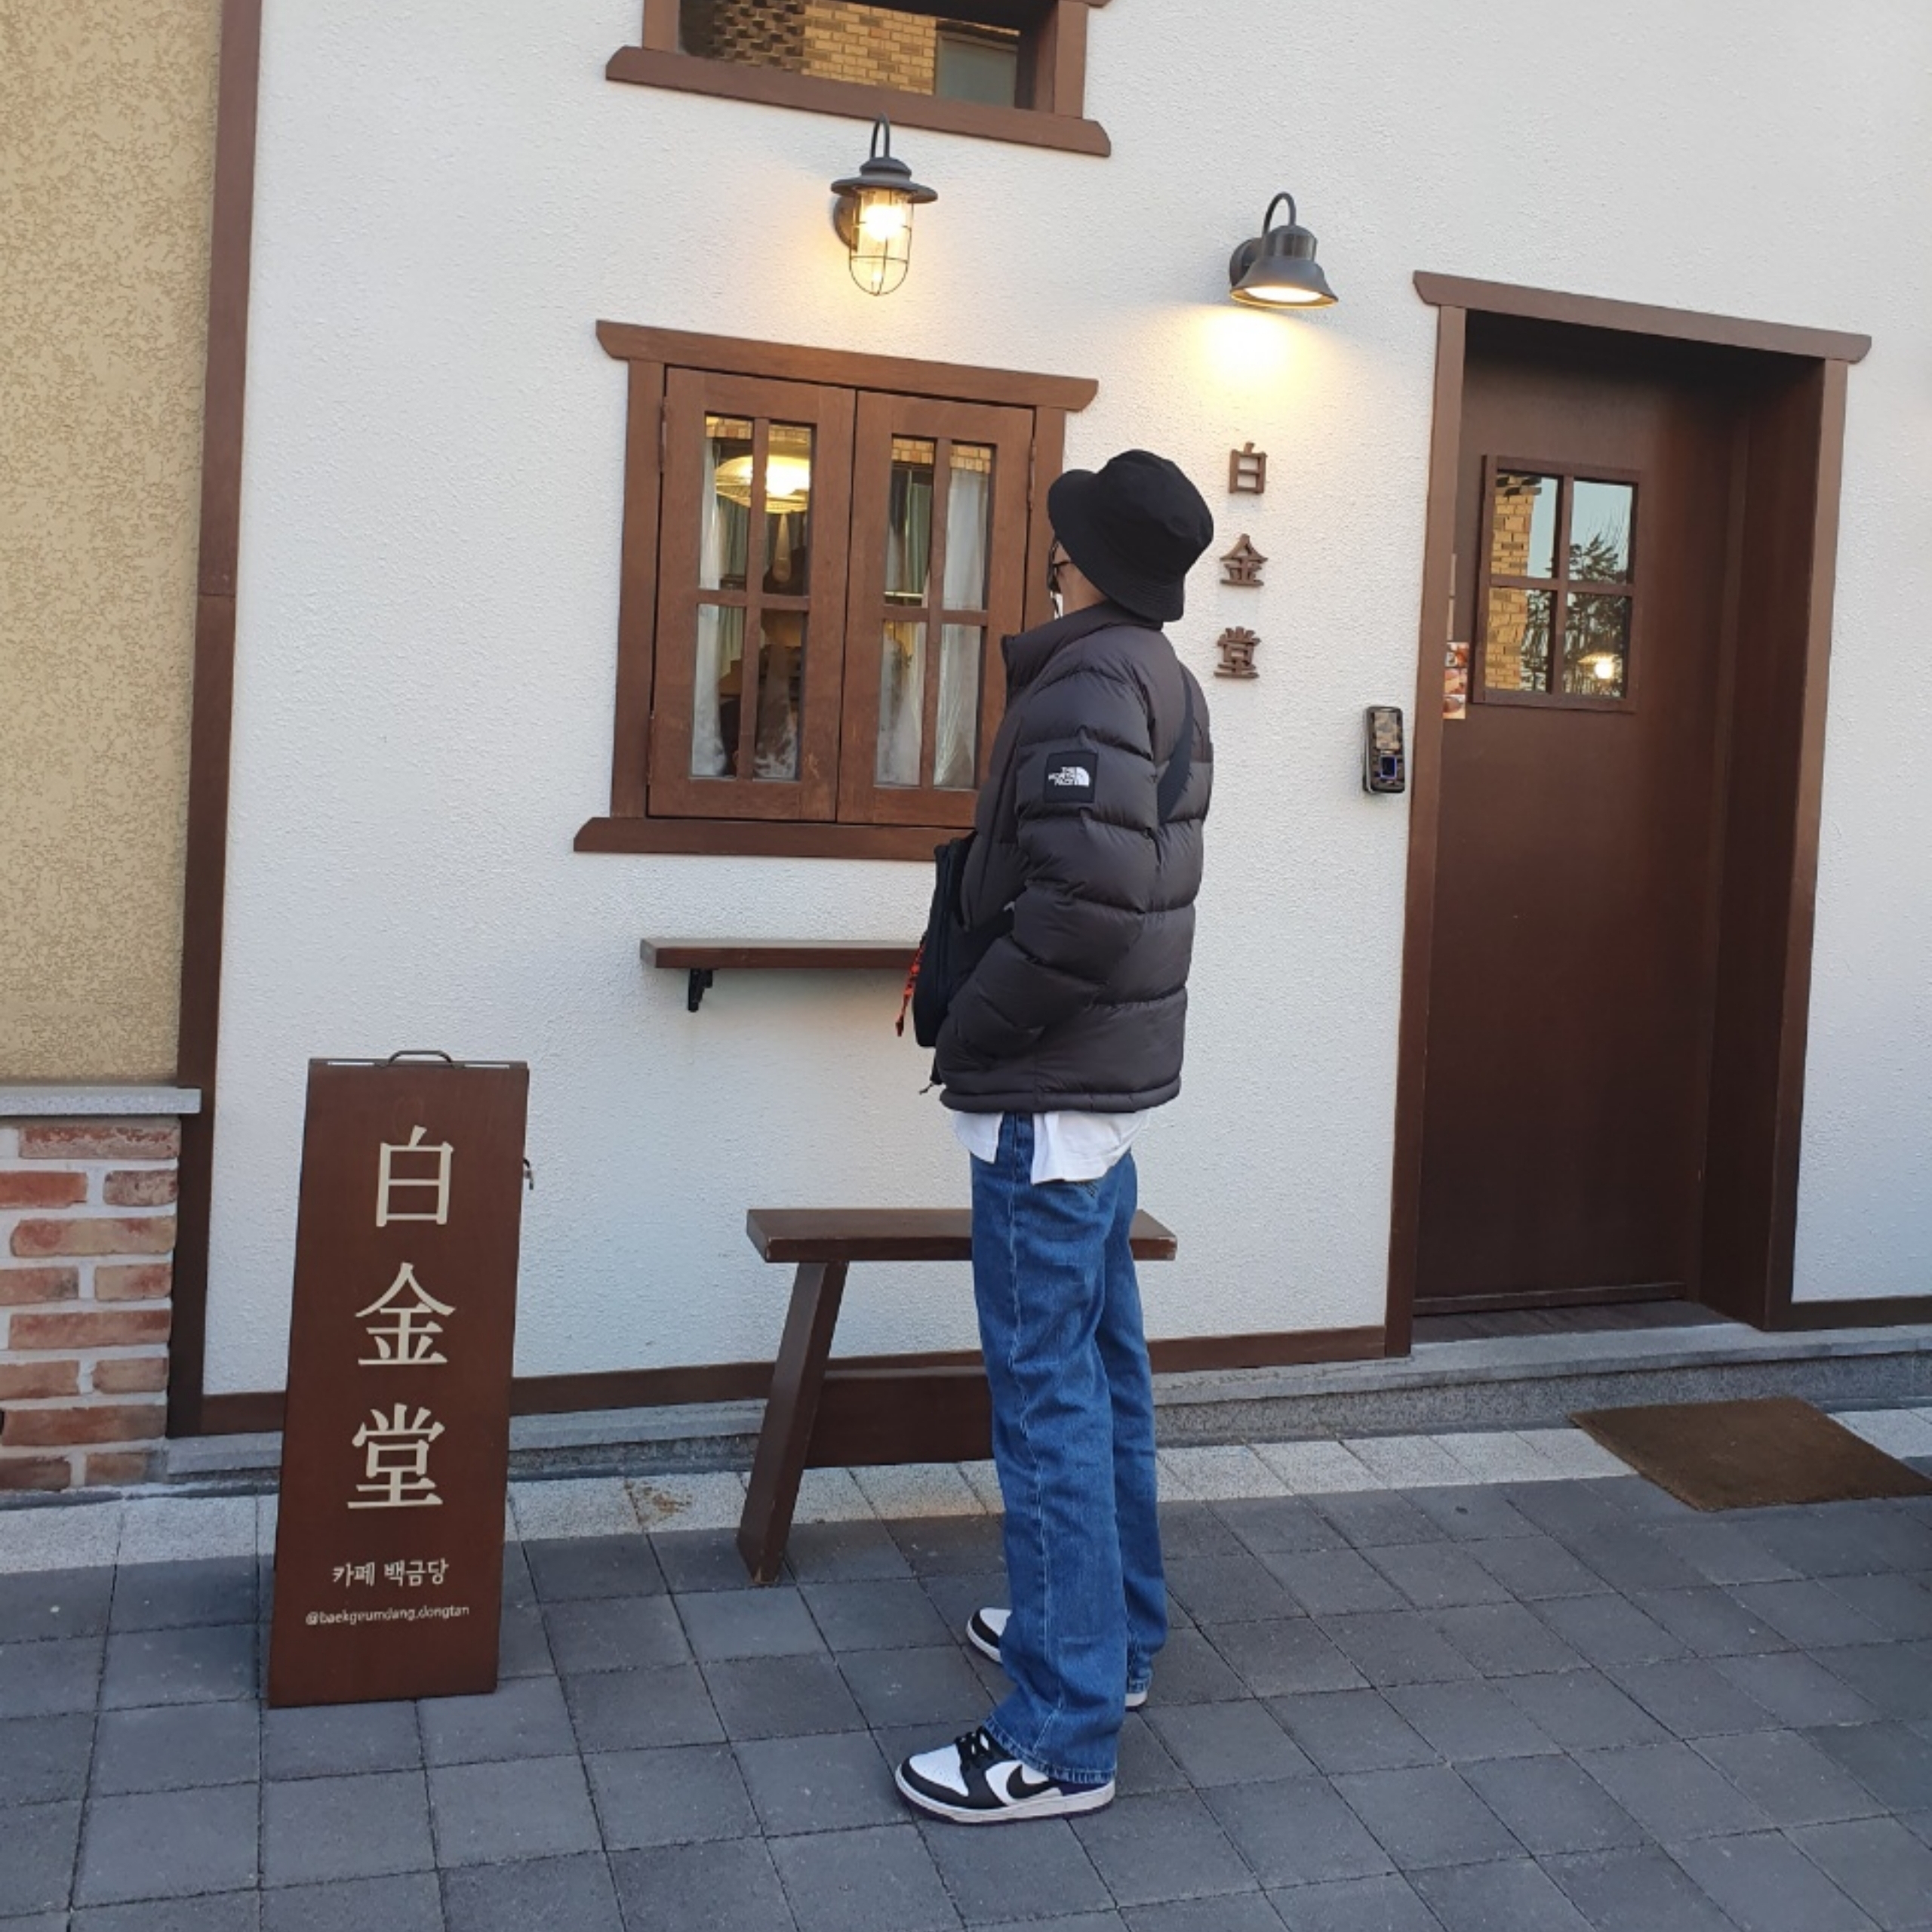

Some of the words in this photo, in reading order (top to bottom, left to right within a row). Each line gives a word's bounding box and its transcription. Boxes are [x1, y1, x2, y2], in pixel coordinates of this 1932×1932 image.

[1214, 441, 1269, 679] 白金堂
[347, 1124, 456, 1509] 白金堂
[332, 1561, 375, 1588] 카페
[383, 1558, 450, 1587] 백금당
